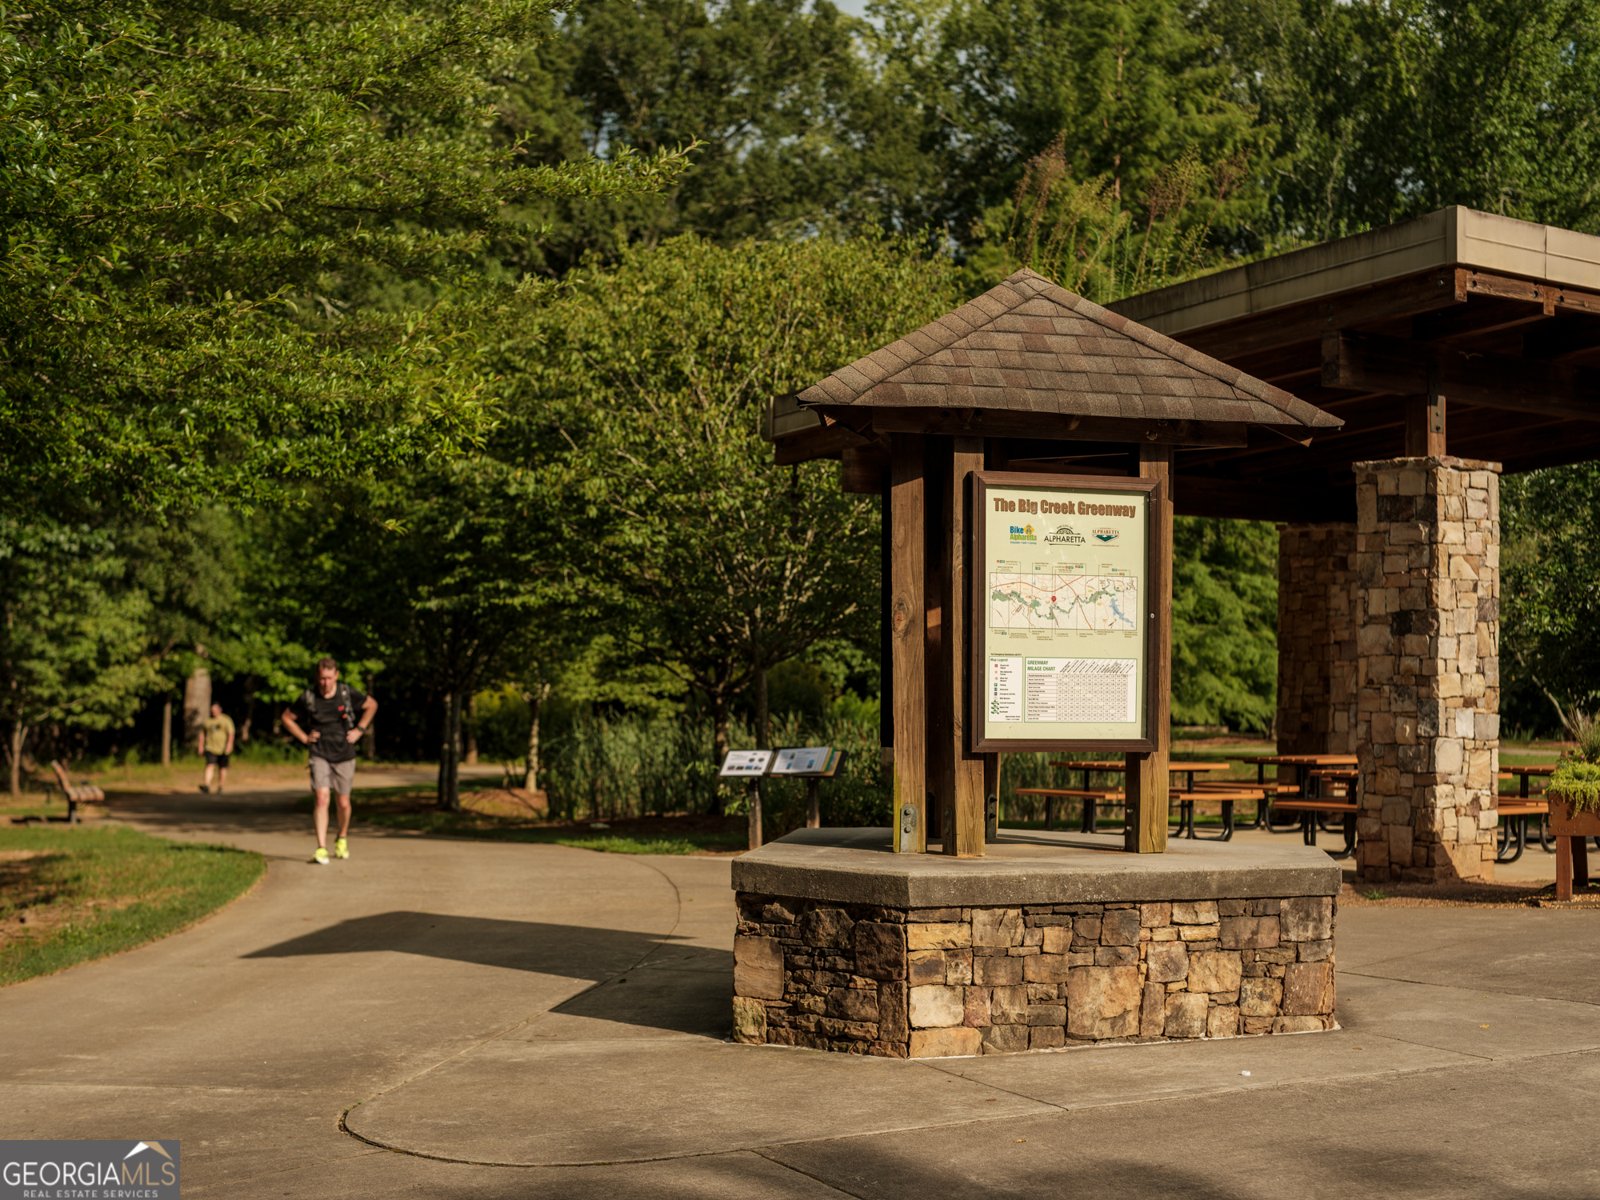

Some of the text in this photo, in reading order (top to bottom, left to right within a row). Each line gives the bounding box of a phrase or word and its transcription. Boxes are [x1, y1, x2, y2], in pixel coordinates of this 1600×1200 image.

[993, 497, 1136, 518] The Big Creek Greenway
[1009, 525, 1024, 534] Bike
[1009, 533, 1037, 541] Alpharetta
[1044, 535, 1086, 544] ALPHARETTA
